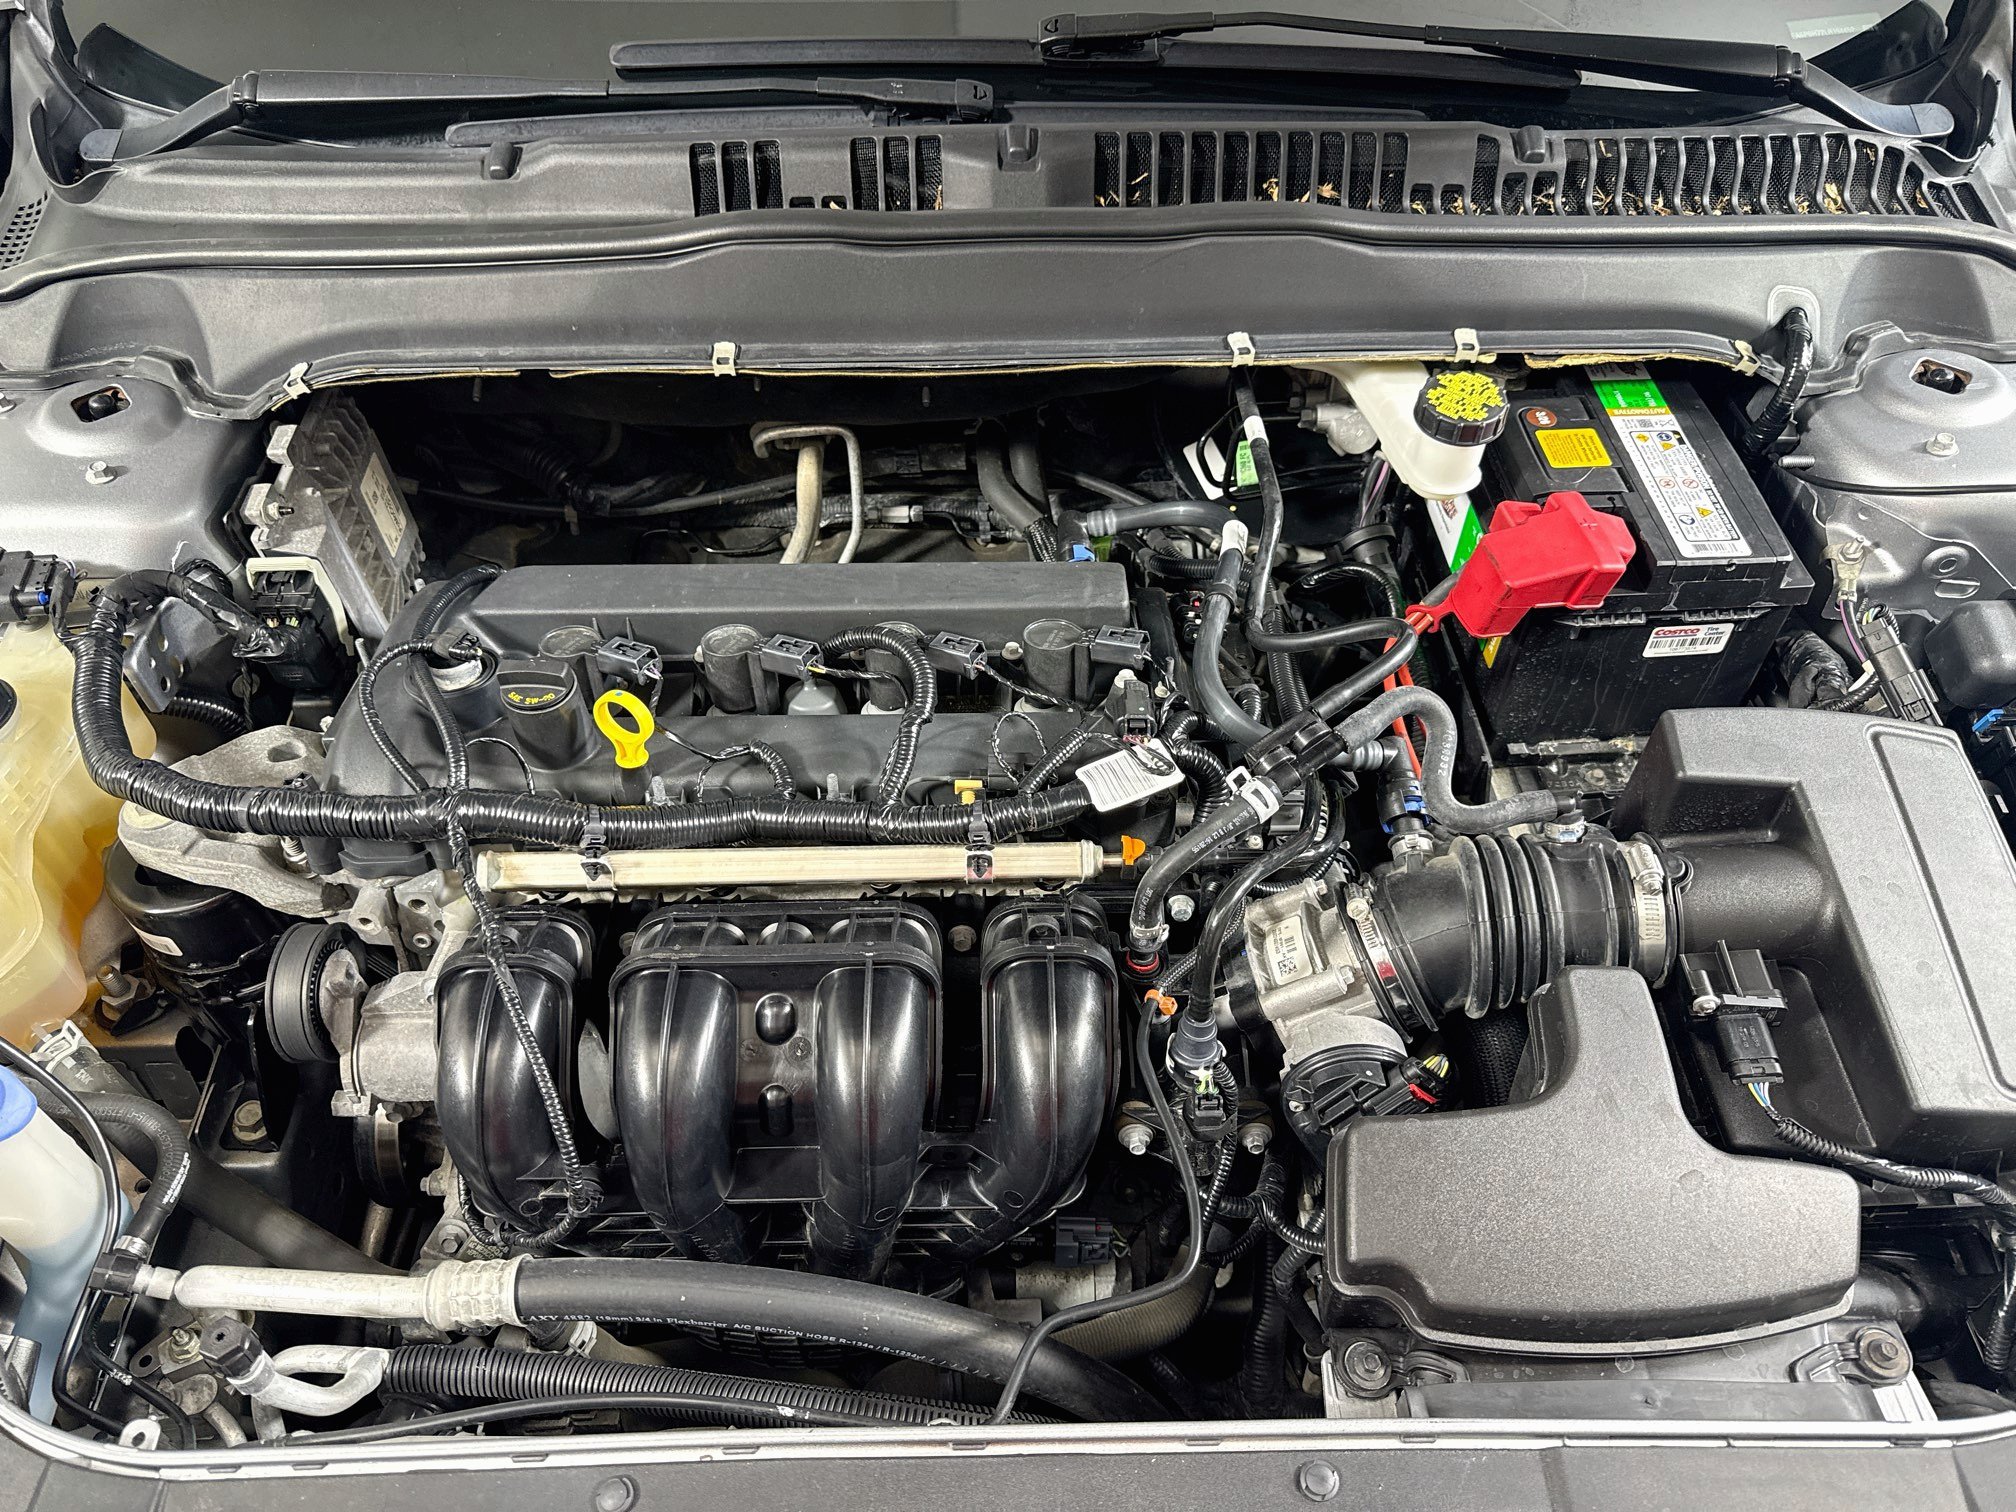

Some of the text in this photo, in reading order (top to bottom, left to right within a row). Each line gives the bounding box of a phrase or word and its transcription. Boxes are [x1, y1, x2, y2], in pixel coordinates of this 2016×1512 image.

[1653, 628, 1701, 636] COSTCO
[508, 691, 524, 703] SAE
[666, 1317, 728, 1329] Flexbarrier
[733, 1323, 752, 1331] A/C
[754, 1325, 803, 1337] SUCTION
[806, 1333, 836, 1342] HOSE
[838, 1338, 874, 1350] R-134a
